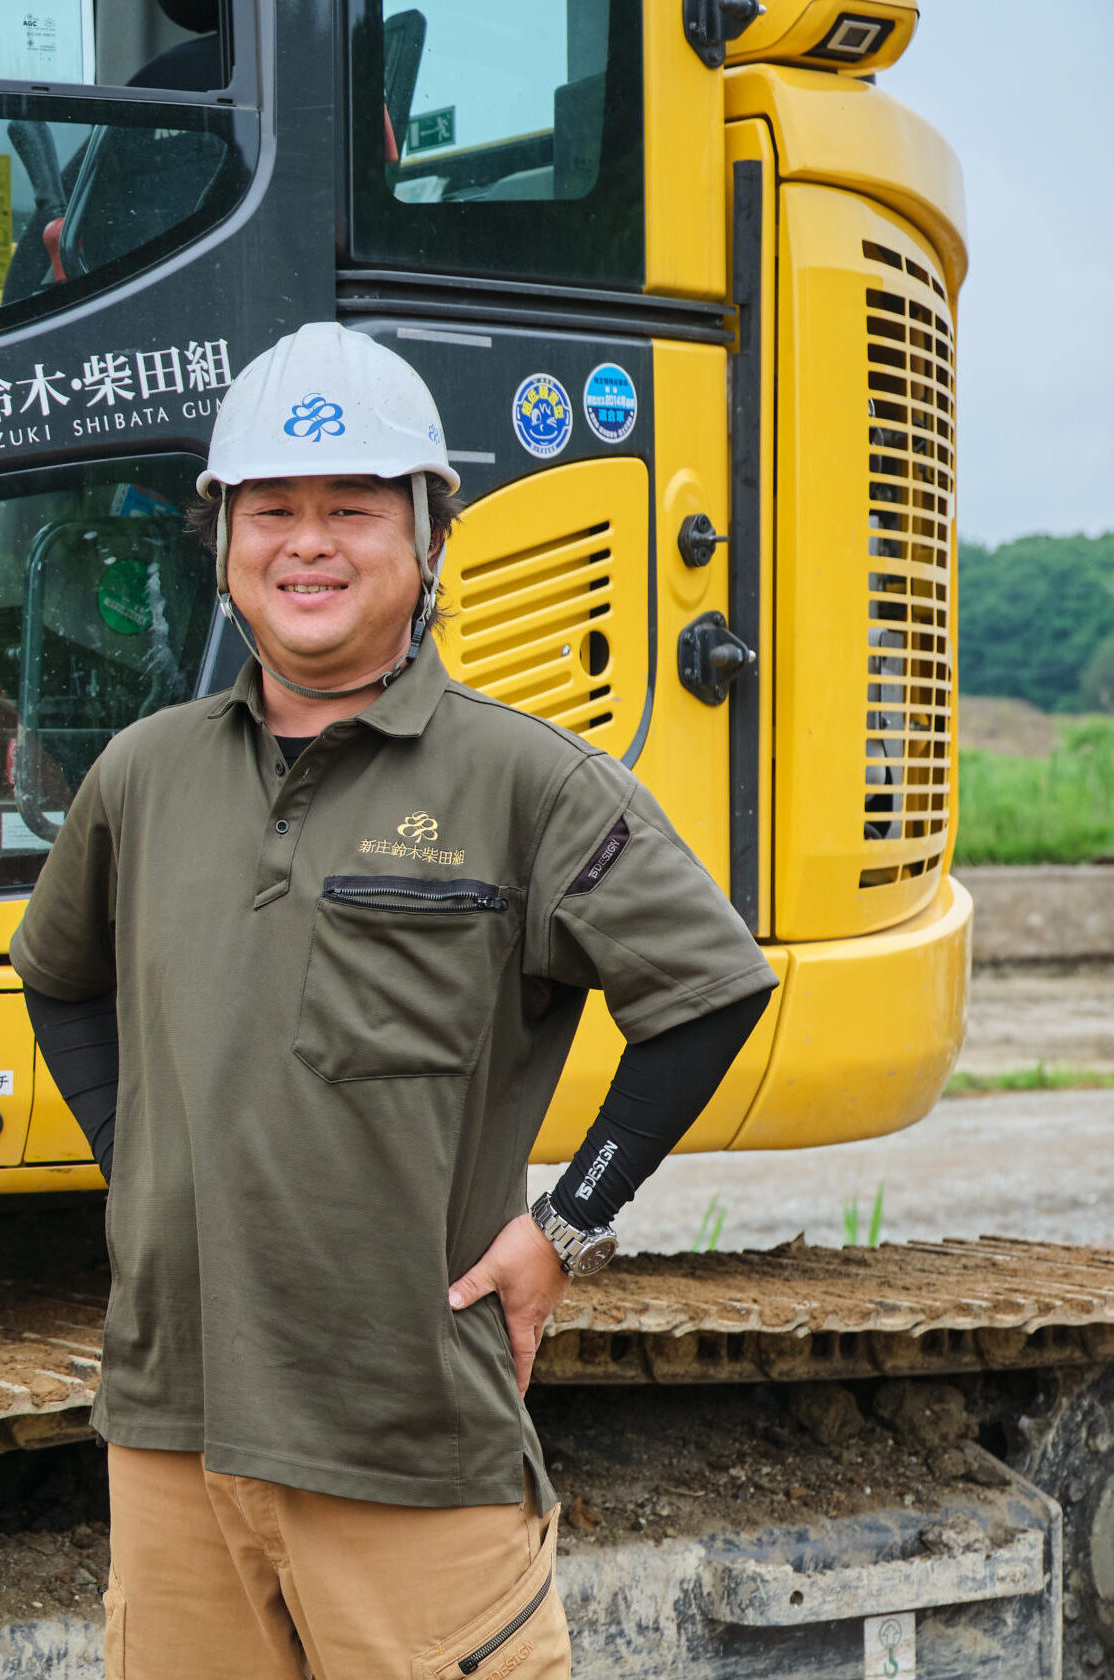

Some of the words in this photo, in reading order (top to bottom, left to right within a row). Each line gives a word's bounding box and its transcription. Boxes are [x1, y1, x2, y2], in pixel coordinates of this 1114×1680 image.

[73, 406, 170, 436] SHIBATA
[358, 838, 465, 865] 新庄鈴木柴田組
[587, 838, 621, 879] TSDESIGN
[574, 1139, 619, 1201] TSDESIGN
